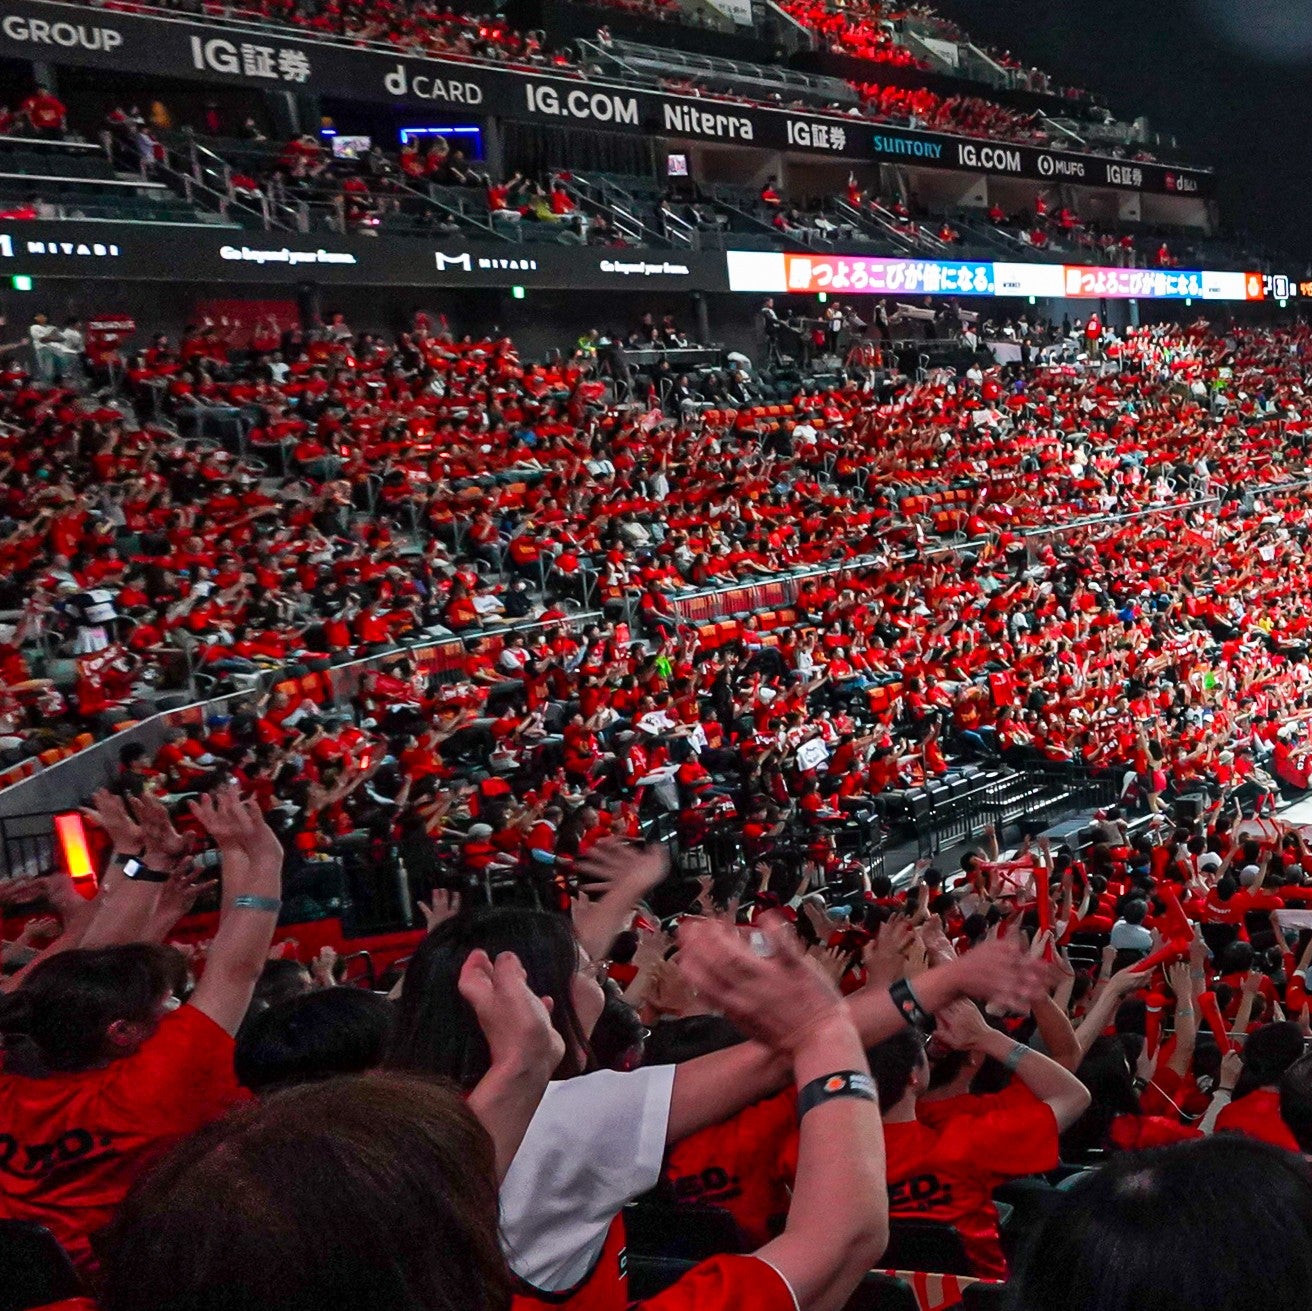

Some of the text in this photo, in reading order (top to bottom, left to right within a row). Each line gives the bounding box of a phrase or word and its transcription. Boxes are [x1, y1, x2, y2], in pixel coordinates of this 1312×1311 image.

[3, 16, 121, 52] GROUP
[190, 35, 311, 83] IG証券
[412, 75, 483, 105] CARD
[525, 83, 640, 125] IG.COM
[662, 103, 754, 140] Niterra
[786, 119, 847, 151] IG証券
[873, 134, 943, 159] SUNTORY
[957, 143, 1022, 172] IG.COM
[1055, 159, 1085, 177] MUFG
[27, 240, 119, 257] MIYABI
[788, 257, 995, 294] つよろこびがになる。
[1066, 269, 1203, 297] つよろこびがになる。
